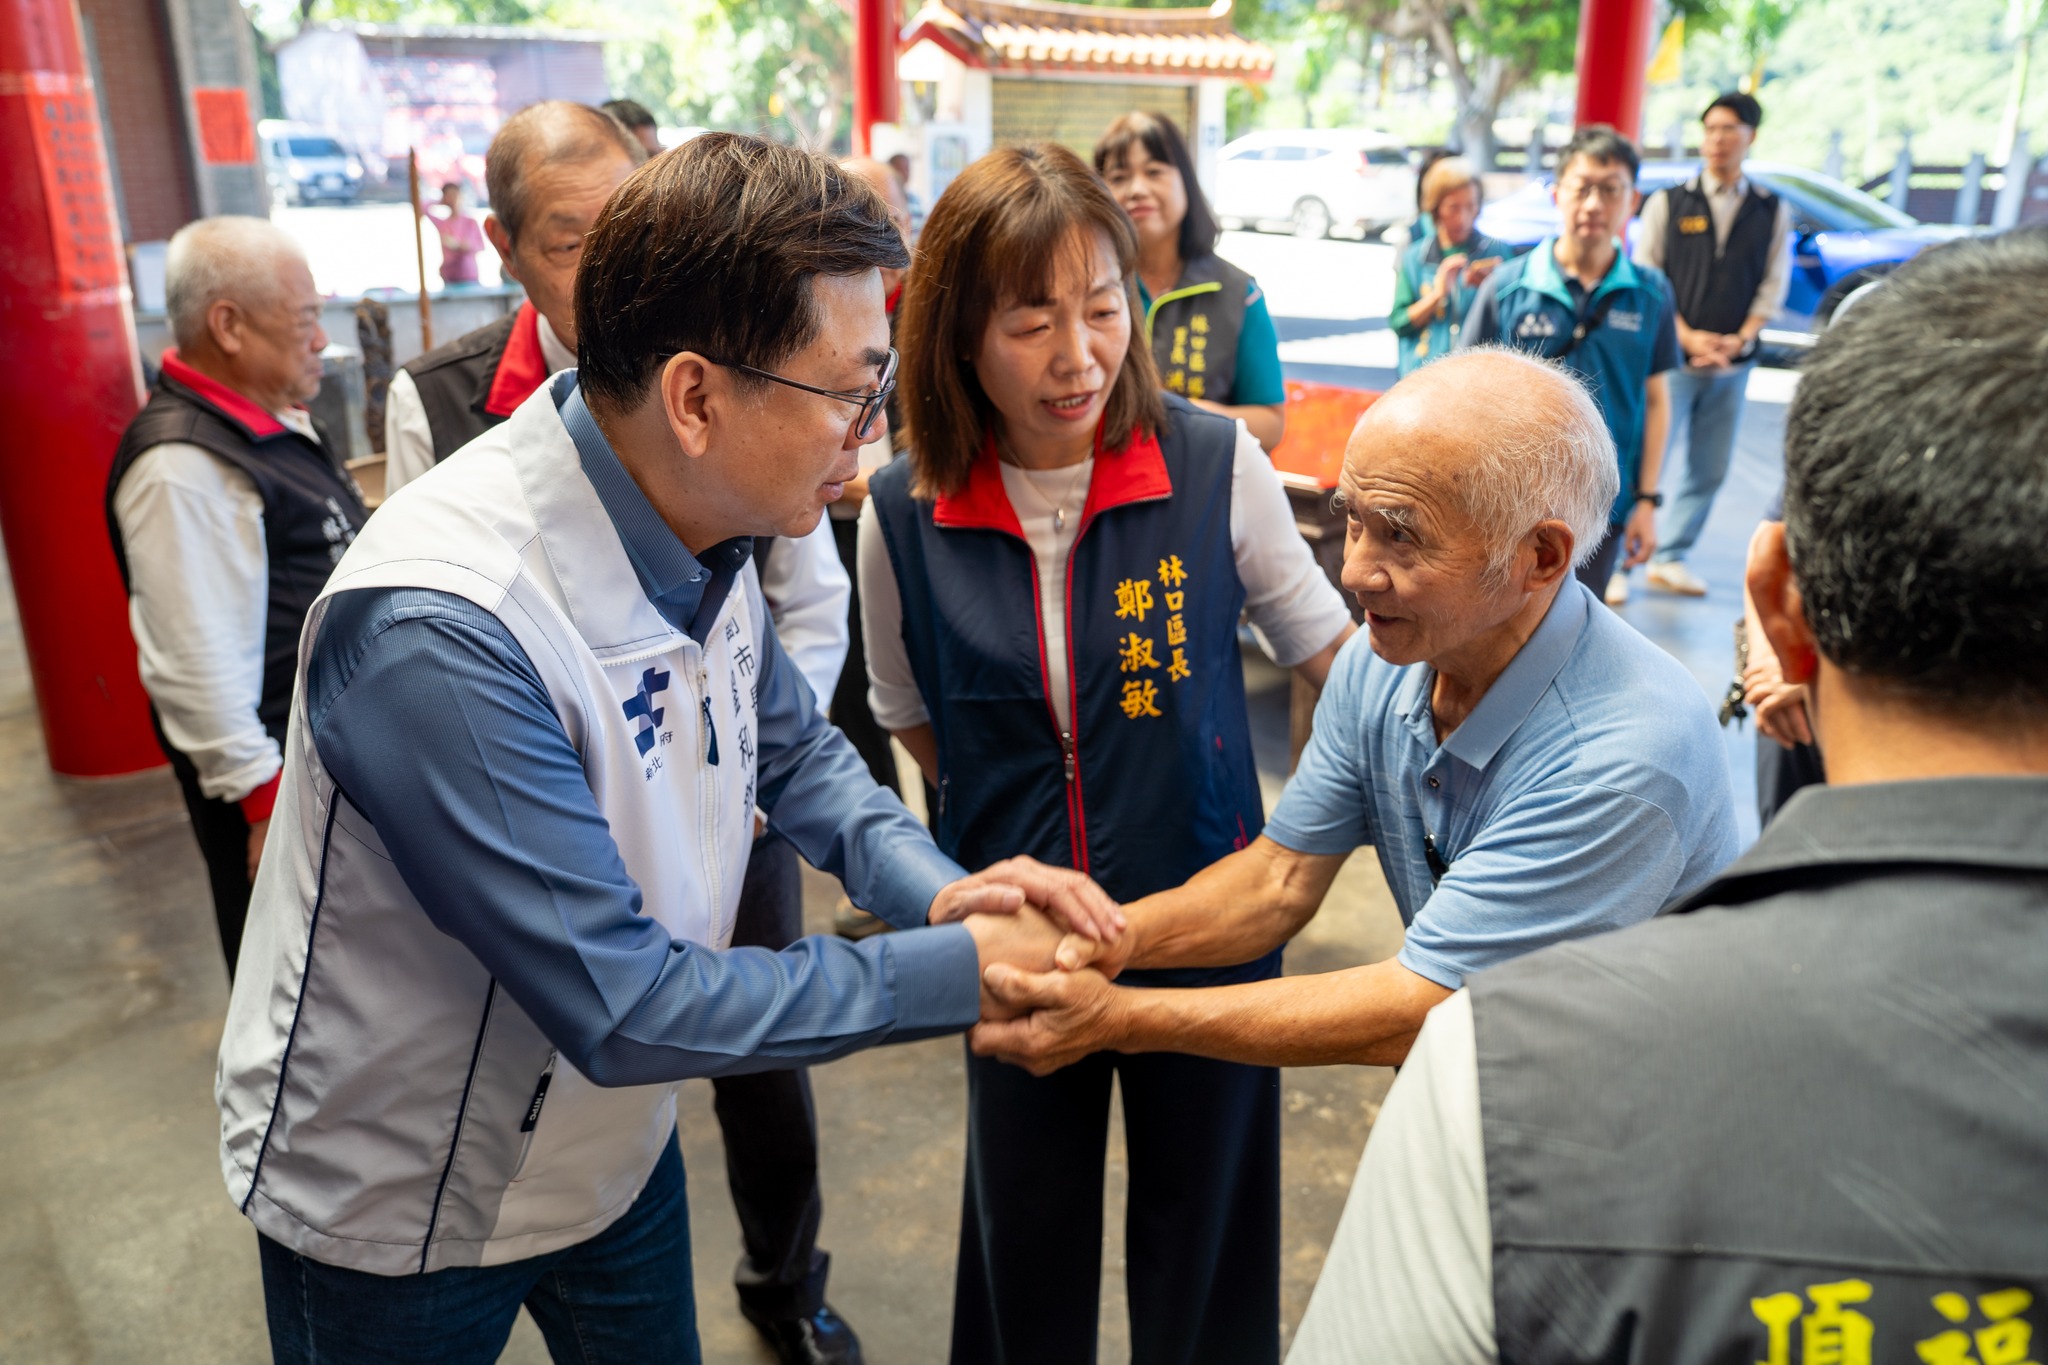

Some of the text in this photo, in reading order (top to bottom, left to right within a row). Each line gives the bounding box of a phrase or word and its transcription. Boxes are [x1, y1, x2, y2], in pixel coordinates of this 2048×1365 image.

[1114, 578, 1163, 719] 鄭淑敏
[1157, 554, 1192, 682] 林口區長
